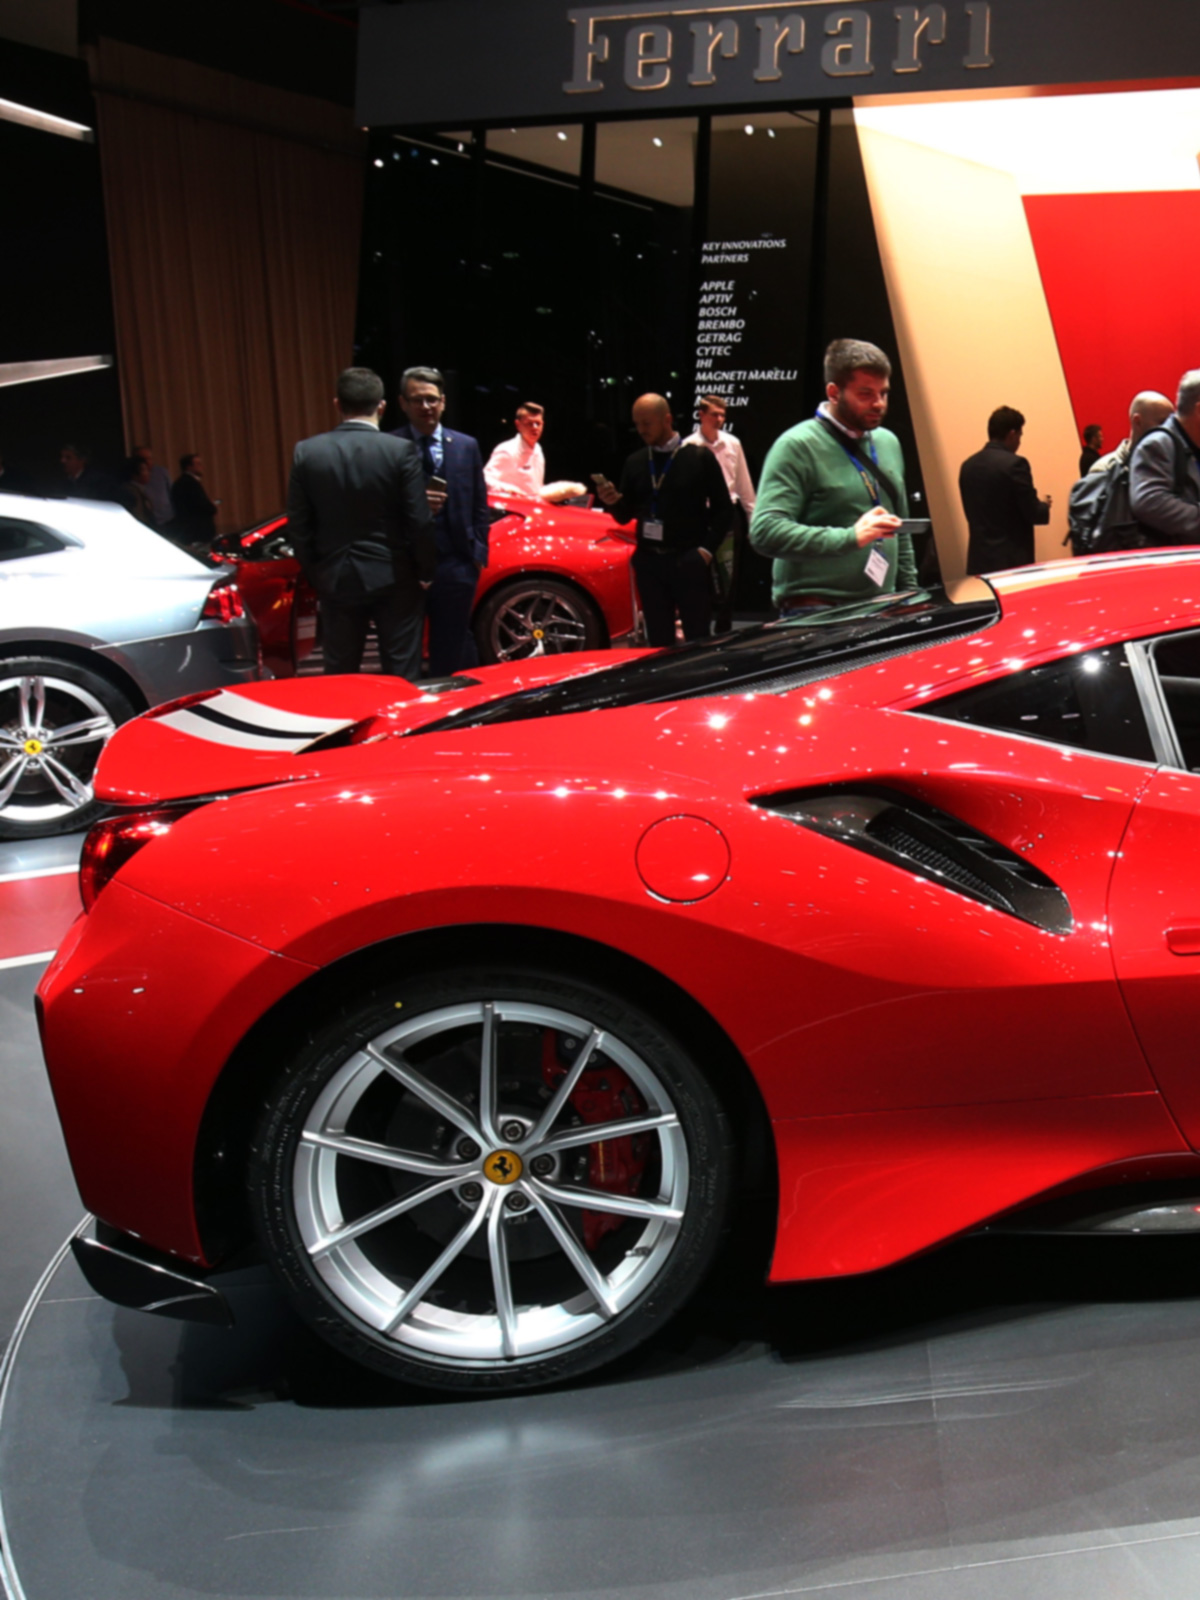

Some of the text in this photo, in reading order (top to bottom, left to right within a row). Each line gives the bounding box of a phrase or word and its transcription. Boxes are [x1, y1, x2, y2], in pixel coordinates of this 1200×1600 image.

[562, 0, 995, 93] Ferrari
[702, 239, 786, 251] KEY INNOVATIONS
[701, 253, 749, 264] PARTNERS
[700, 280, 735, 291] APPLE
[699, 293, 733, 304] APTIV
[698, 306, 737, 317] BOSCH
[697, 319, 746, 330] BREMBO
[696, 332, 742, 343] GETRAG
[696, 345, 732, 356] CYTEC
[695, 358, 713, 369] IHI
[695, 369, 798, 381] MAGNETI MARELLI
[694, 383, 735, 394] MAHLE
